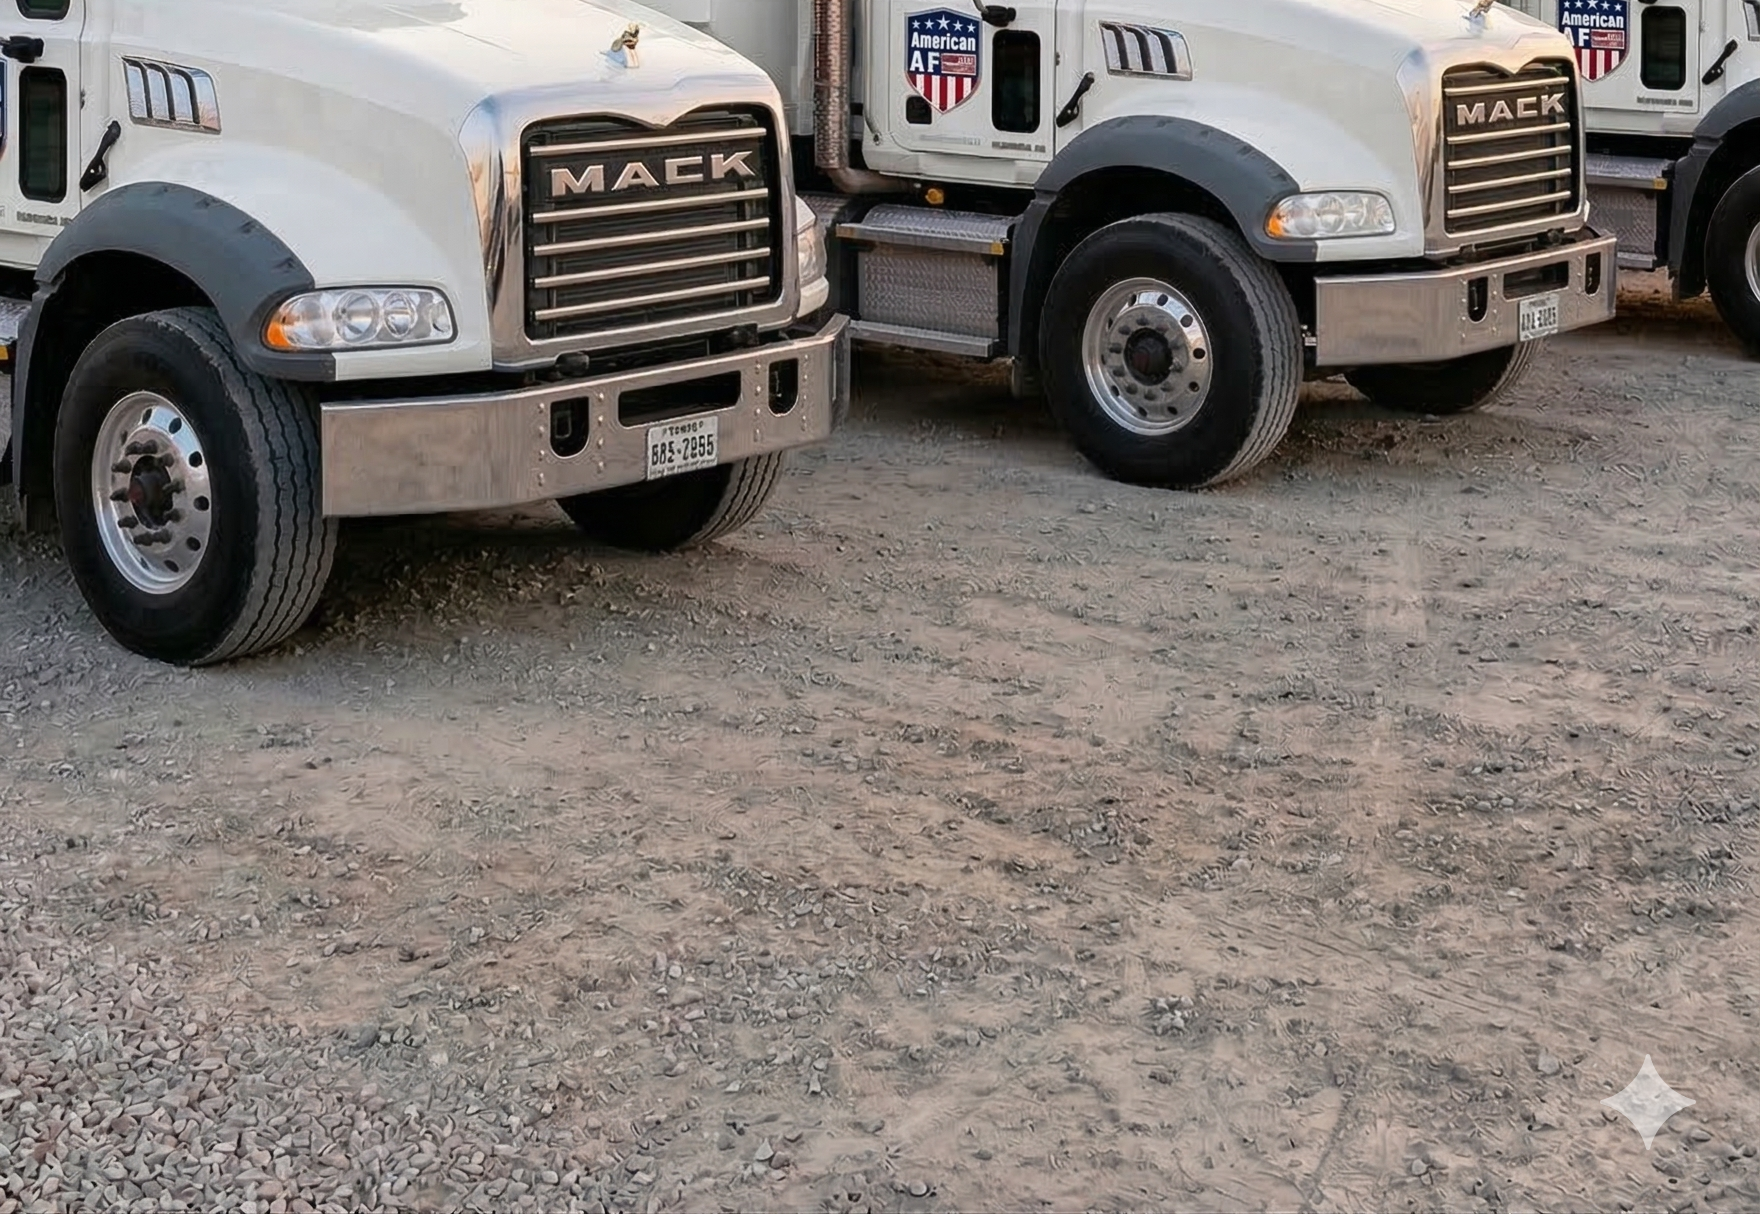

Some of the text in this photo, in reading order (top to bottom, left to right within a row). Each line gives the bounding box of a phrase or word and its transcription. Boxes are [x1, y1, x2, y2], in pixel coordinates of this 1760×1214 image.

[1562, 11, 1624, 29] American
[911, 32, 976, 52] American
[910, 50, 940, 73] AF
[1457, 92, 1566, 126] MACK
[551, 150, 756, 198] MACK
